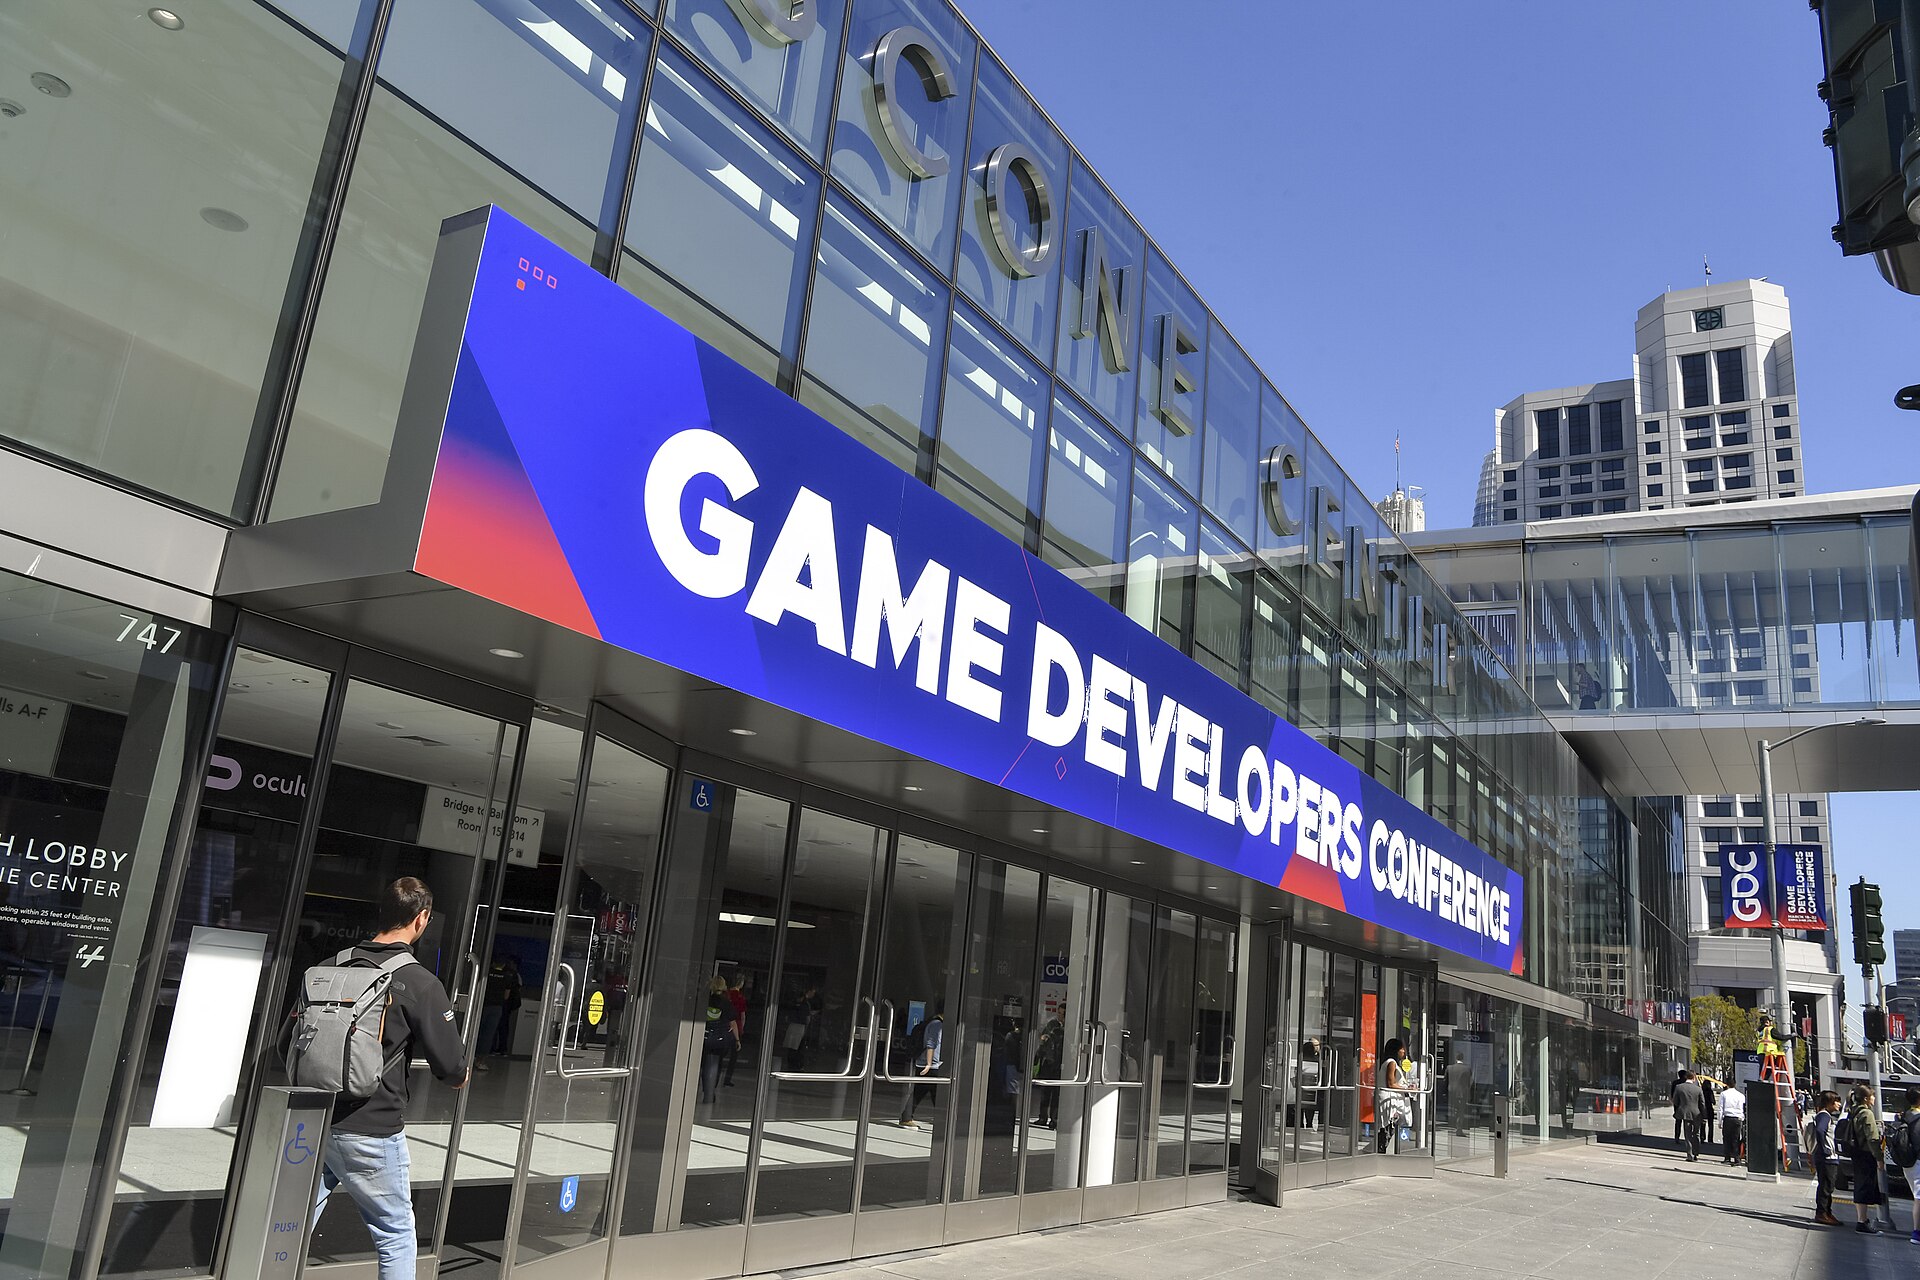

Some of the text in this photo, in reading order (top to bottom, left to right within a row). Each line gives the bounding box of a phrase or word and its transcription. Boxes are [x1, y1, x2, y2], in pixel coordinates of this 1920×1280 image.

[115, 612, 182, 655] 747
[643, 427, 1511, 947] GAME DEVELOPERS CONFERENCE
[17, 703, 49, 719] A-F
[443, 797, 474, 815] Bridge
[25, 838, 128, 872] LOBBY
[29, 871, 121, 898] CENTER
[1728, 850, 1762, 922] GDC
[1795, 850, 1807, 914] DEVELOPERS
[1805, 851, 1817, 915] CONFERENCE
[1786, 885, 1797, 914] GAME
[20, 907, 40, 916] within
[40, 909, 49, 917] 25
[49, 910, 63, 919] feet
[63, 911, 71, 919] of
[71, 912, 97, 924] building
[97, 916, 113, 924] exits,
[20, 917, 51, 926] operable
[51, 920, 79, 930] windows
[79, 922, 93, 930] and
[92, 924, 112, 932] vents.
[273, 1222, 299, 1233] PUSH
[274, 1251, 288, 1262] TO
